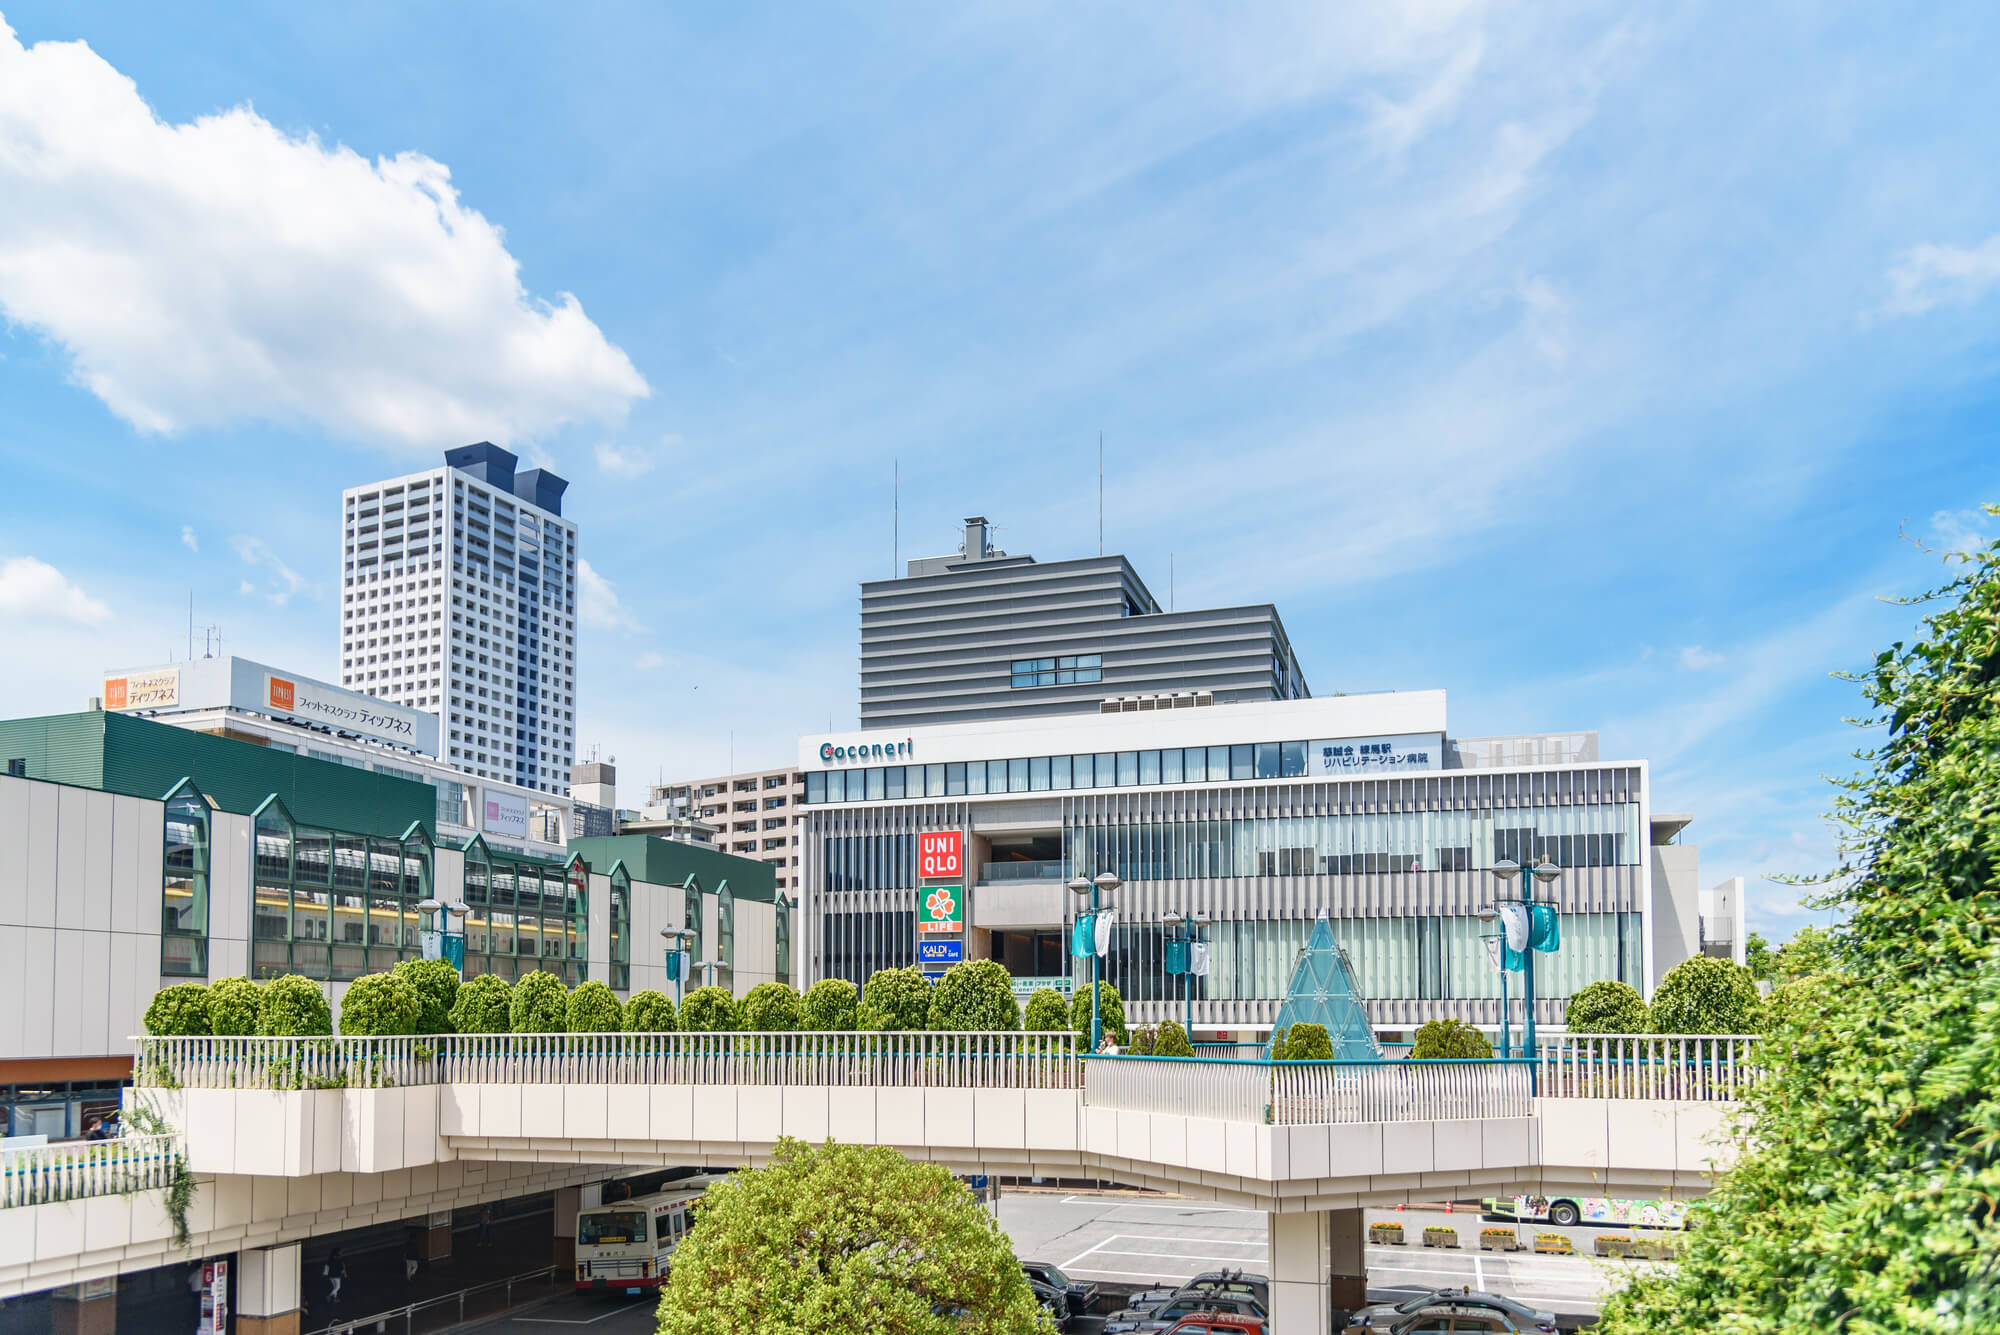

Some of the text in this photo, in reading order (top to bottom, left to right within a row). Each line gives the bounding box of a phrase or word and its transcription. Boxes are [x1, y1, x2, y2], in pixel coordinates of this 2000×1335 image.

[359, 709, 413, 736] ティップネス
[820, 737, 912, 761] Coconeri
[925, 837, 954, 853] UNI
[925, 855, 957, 874] QLO
[928, 922, 953, 931] LIFE
[923, 945, 947, 954] KALDI
